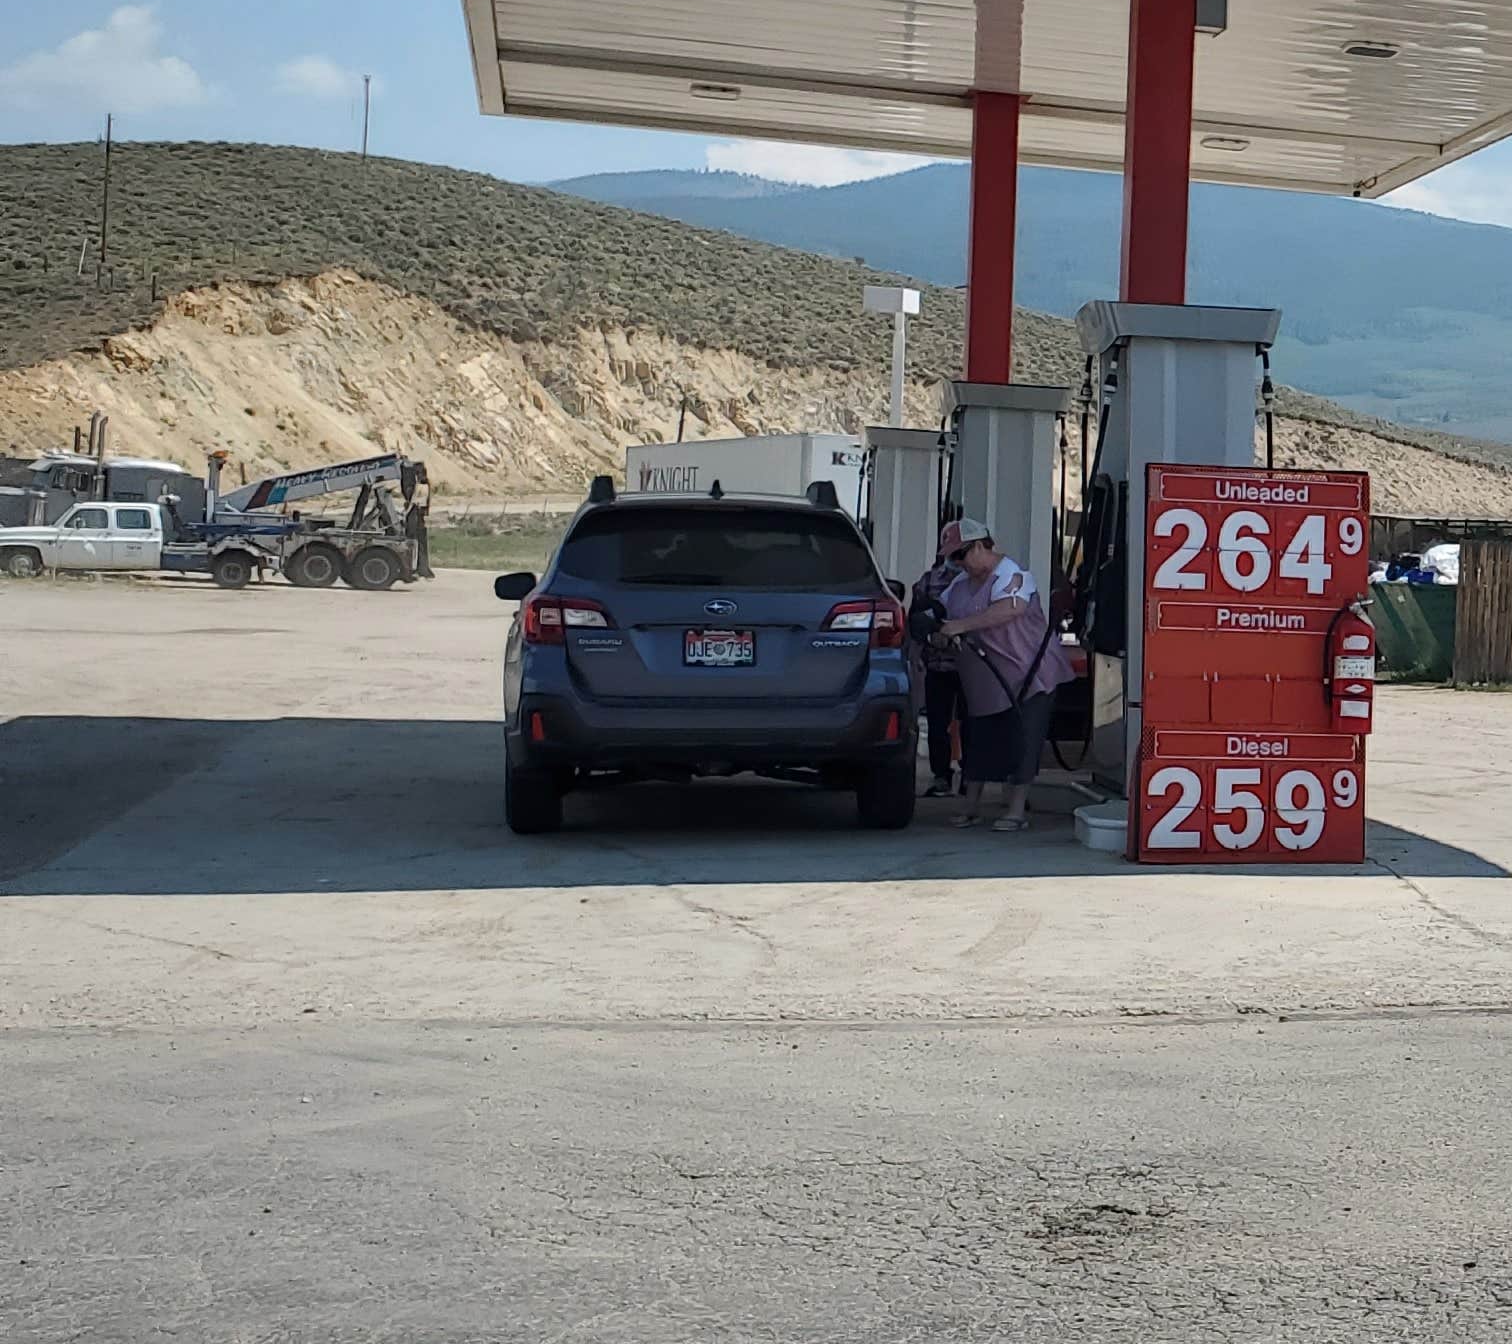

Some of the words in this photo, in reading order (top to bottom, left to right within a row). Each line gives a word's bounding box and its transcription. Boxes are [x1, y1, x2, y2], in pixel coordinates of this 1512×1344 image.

[653, 466, 699, 491] KNIGHT
[1215, 480, 1309, 503] Unleaded
[1216, 608, 1305, 629] Premium
[1227, 736, 1289, 756] Diesel
